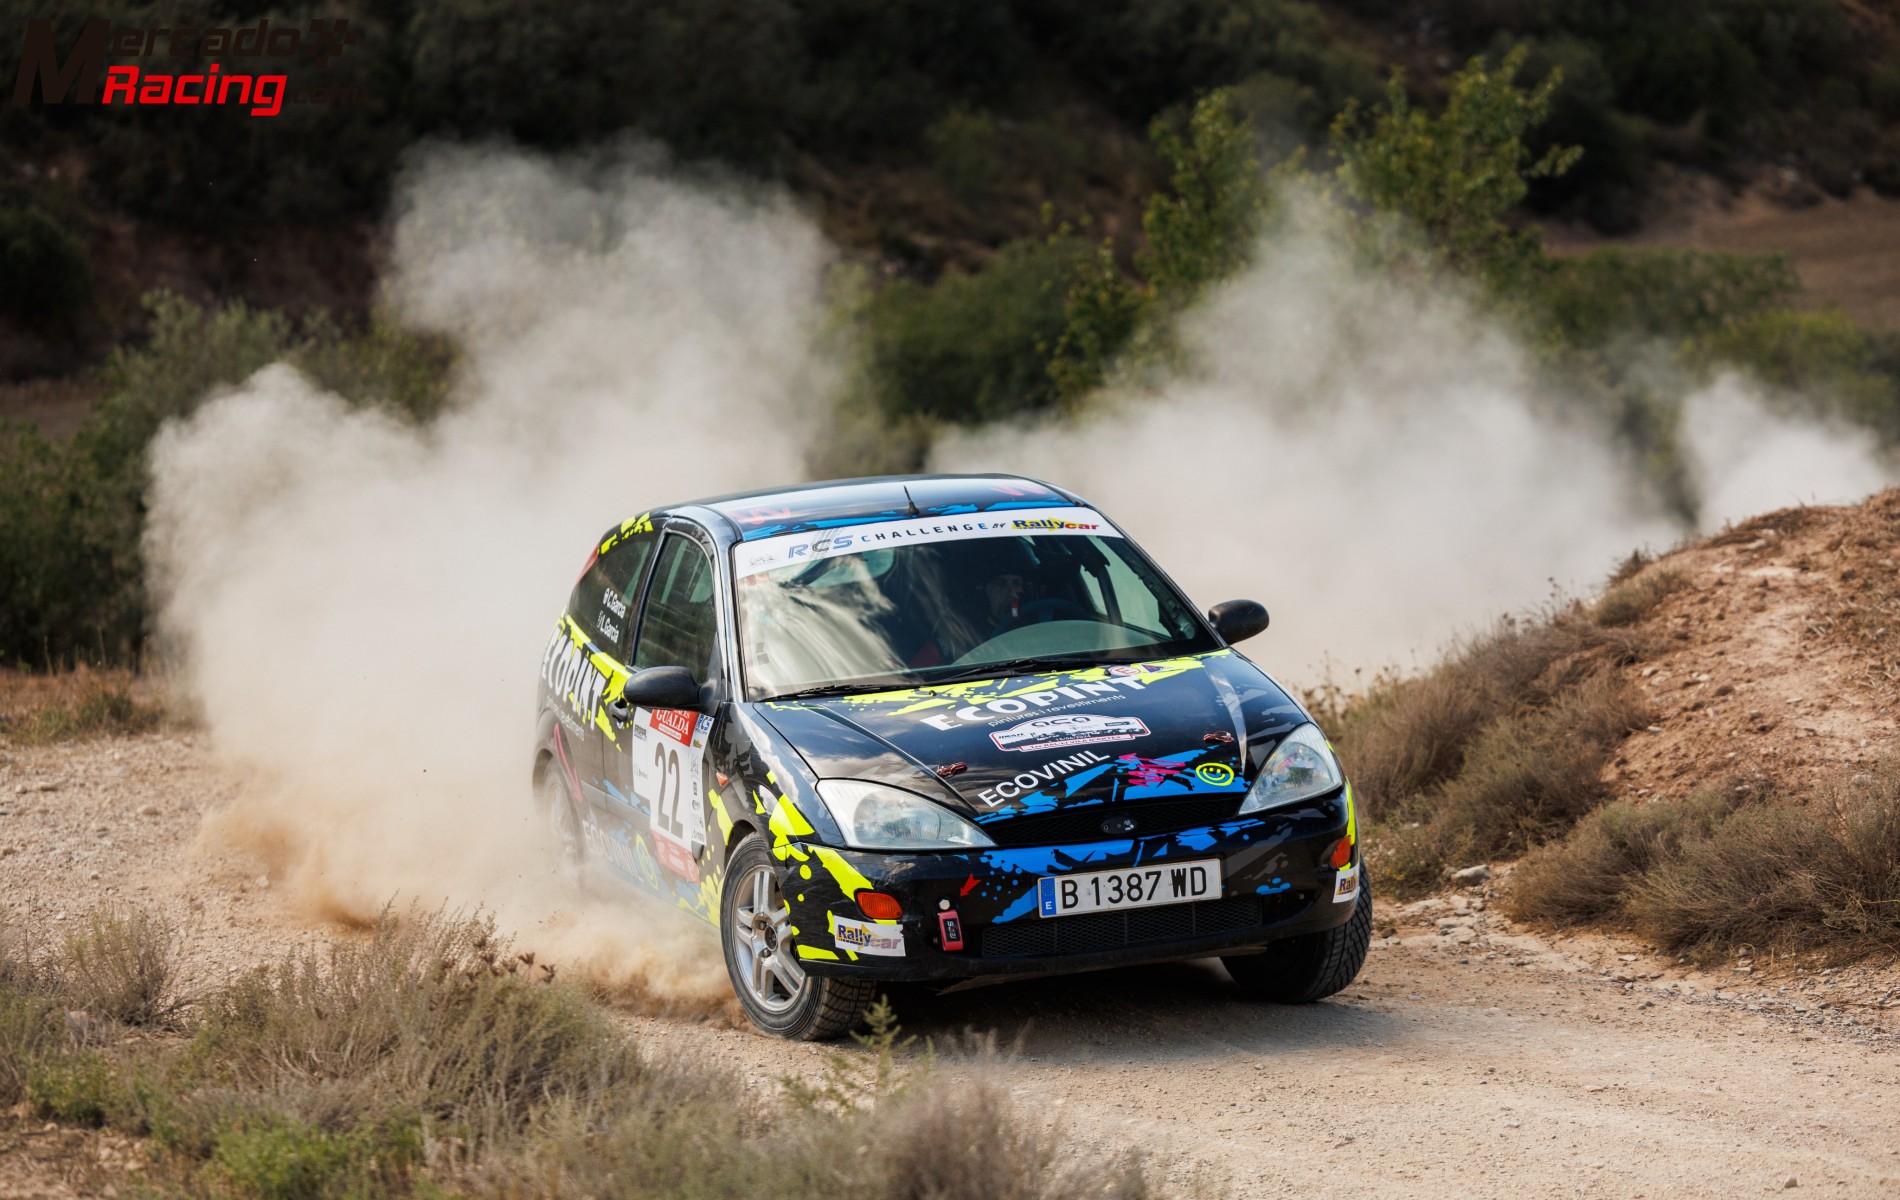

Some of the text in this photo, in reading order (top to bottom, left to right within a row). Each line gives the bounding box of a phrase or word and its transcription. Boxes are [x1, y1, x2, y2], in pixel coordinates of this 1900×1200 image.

[788, 535, 854, 558] RCS
[861, 522, 988, 542] CHALLENGE
[1012, 519, 1099, 530] Rallycar
[541, 626, 607, 730] ECOPINT
[656, 708, 689, 735] GUALDA
[920, 677, 1146, 731] ECOPINT
[987, 709, 1039, 728] pintures
[1046, 694, 1127, 713] revestiments
[655, 741, 684, 840] 22
[978, 750, 1110, 807] ECOVINIL
[1045, 901, 1053, 910] E
[1061, 866, 1207, 909] B 1387 WD
[837, 923, 902, 949] Rallycar
